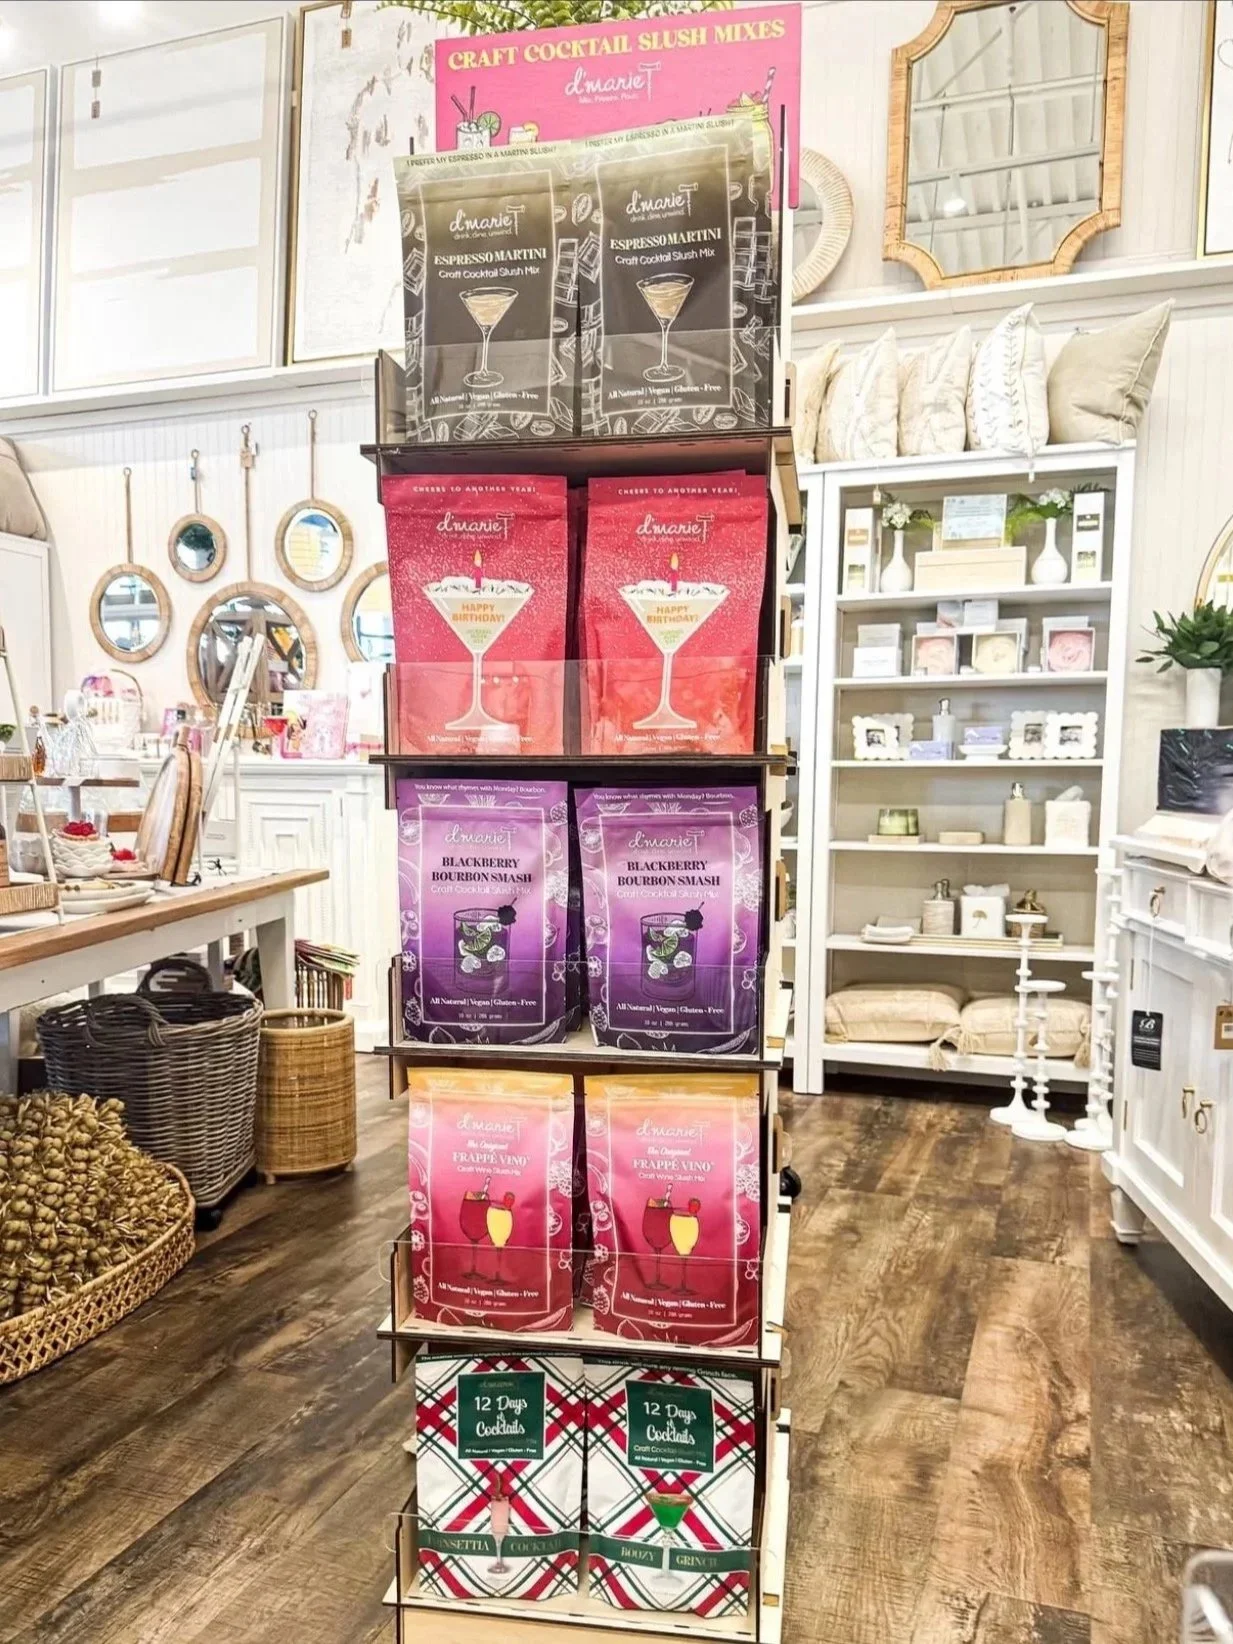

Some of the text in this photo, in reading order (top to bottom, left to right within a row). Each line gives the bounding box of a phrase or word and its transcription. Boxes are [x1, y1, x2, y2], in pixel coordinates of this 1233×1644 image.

[448, 19, 785, 70] CRAFT COCKTAIL SLUSH MIXES
[411, 158, 434, 166] PREFER
[449, 154, 484, 162] ESPRESSO
[500, 149, 528, 157] MARTINI
[610, 228, 721, 250] ESPRESSO MARTINI
[434, 248, 546, 265] ESPRESSO MARTINI
[615, 248, 715, 265] Craft Cocktail Slush Mix
[439, 266, 539, 278] Craft Cocktail Slush Mix
[430, 397, 440, 405] All
[440, 394, 464, 403] Natural
[469, 393, 490, 401] Vegan
[608, 392, 618, 400] All
[618, 387, 644, 397] Natural
[649, 387, 670, 395] Vegan
[462, 604, 495, 612] HAPPY
[452, 614, 505, 623] BIRTHDAY!
[458, 785, 479, 793] rhymes
[442, 856, 520, 868] BLACKBERRY
[627, 861, 707, 871] BLACKBERRY
[432, 872, 532, 883] BOURBON SMASH
[618, 876, 720, 886] BOURBON SMASH
[431, 884, 452, 893] Craft
[454, 885, 489, 894] Cocktail
[617, 890, 638, 898] Craft
[640, 890, 677, 899] Cocktail
[679, 890, 702, 899] Slush
[441, 998, 466, 1006] Natural
[470, 998, 490, 1007] Vegan
[627, 1004, 653, 1012] Natural
[655, 1005, 676, 1013] Vegan
[680, 1006, 703, 1014] Gluten
[453, 1151, 498, 1164] FRAPPÉ
[633, 1158, 679, 1170] FRAPPÉ
[449, 1284, 470, 1294] Natural
[473, 1287, 493, 1296] Vegan
[632, 1294, 654, 1305] Natural
[658, 1299, 679, 1307] Vegan
[710, 1301, 726, 1309] Free
[475, 1395, 527, 1414] 12 Days
[644, 1402, 696, 1425] 12 Days
[476, 1420, 525, 1436] Cocktails
[646, 1424, 695, 1445] Cocktails
[633, 1444, 649, 1452] Craft
[621, 1546, 717, 1568] BOOZY GRINCH
